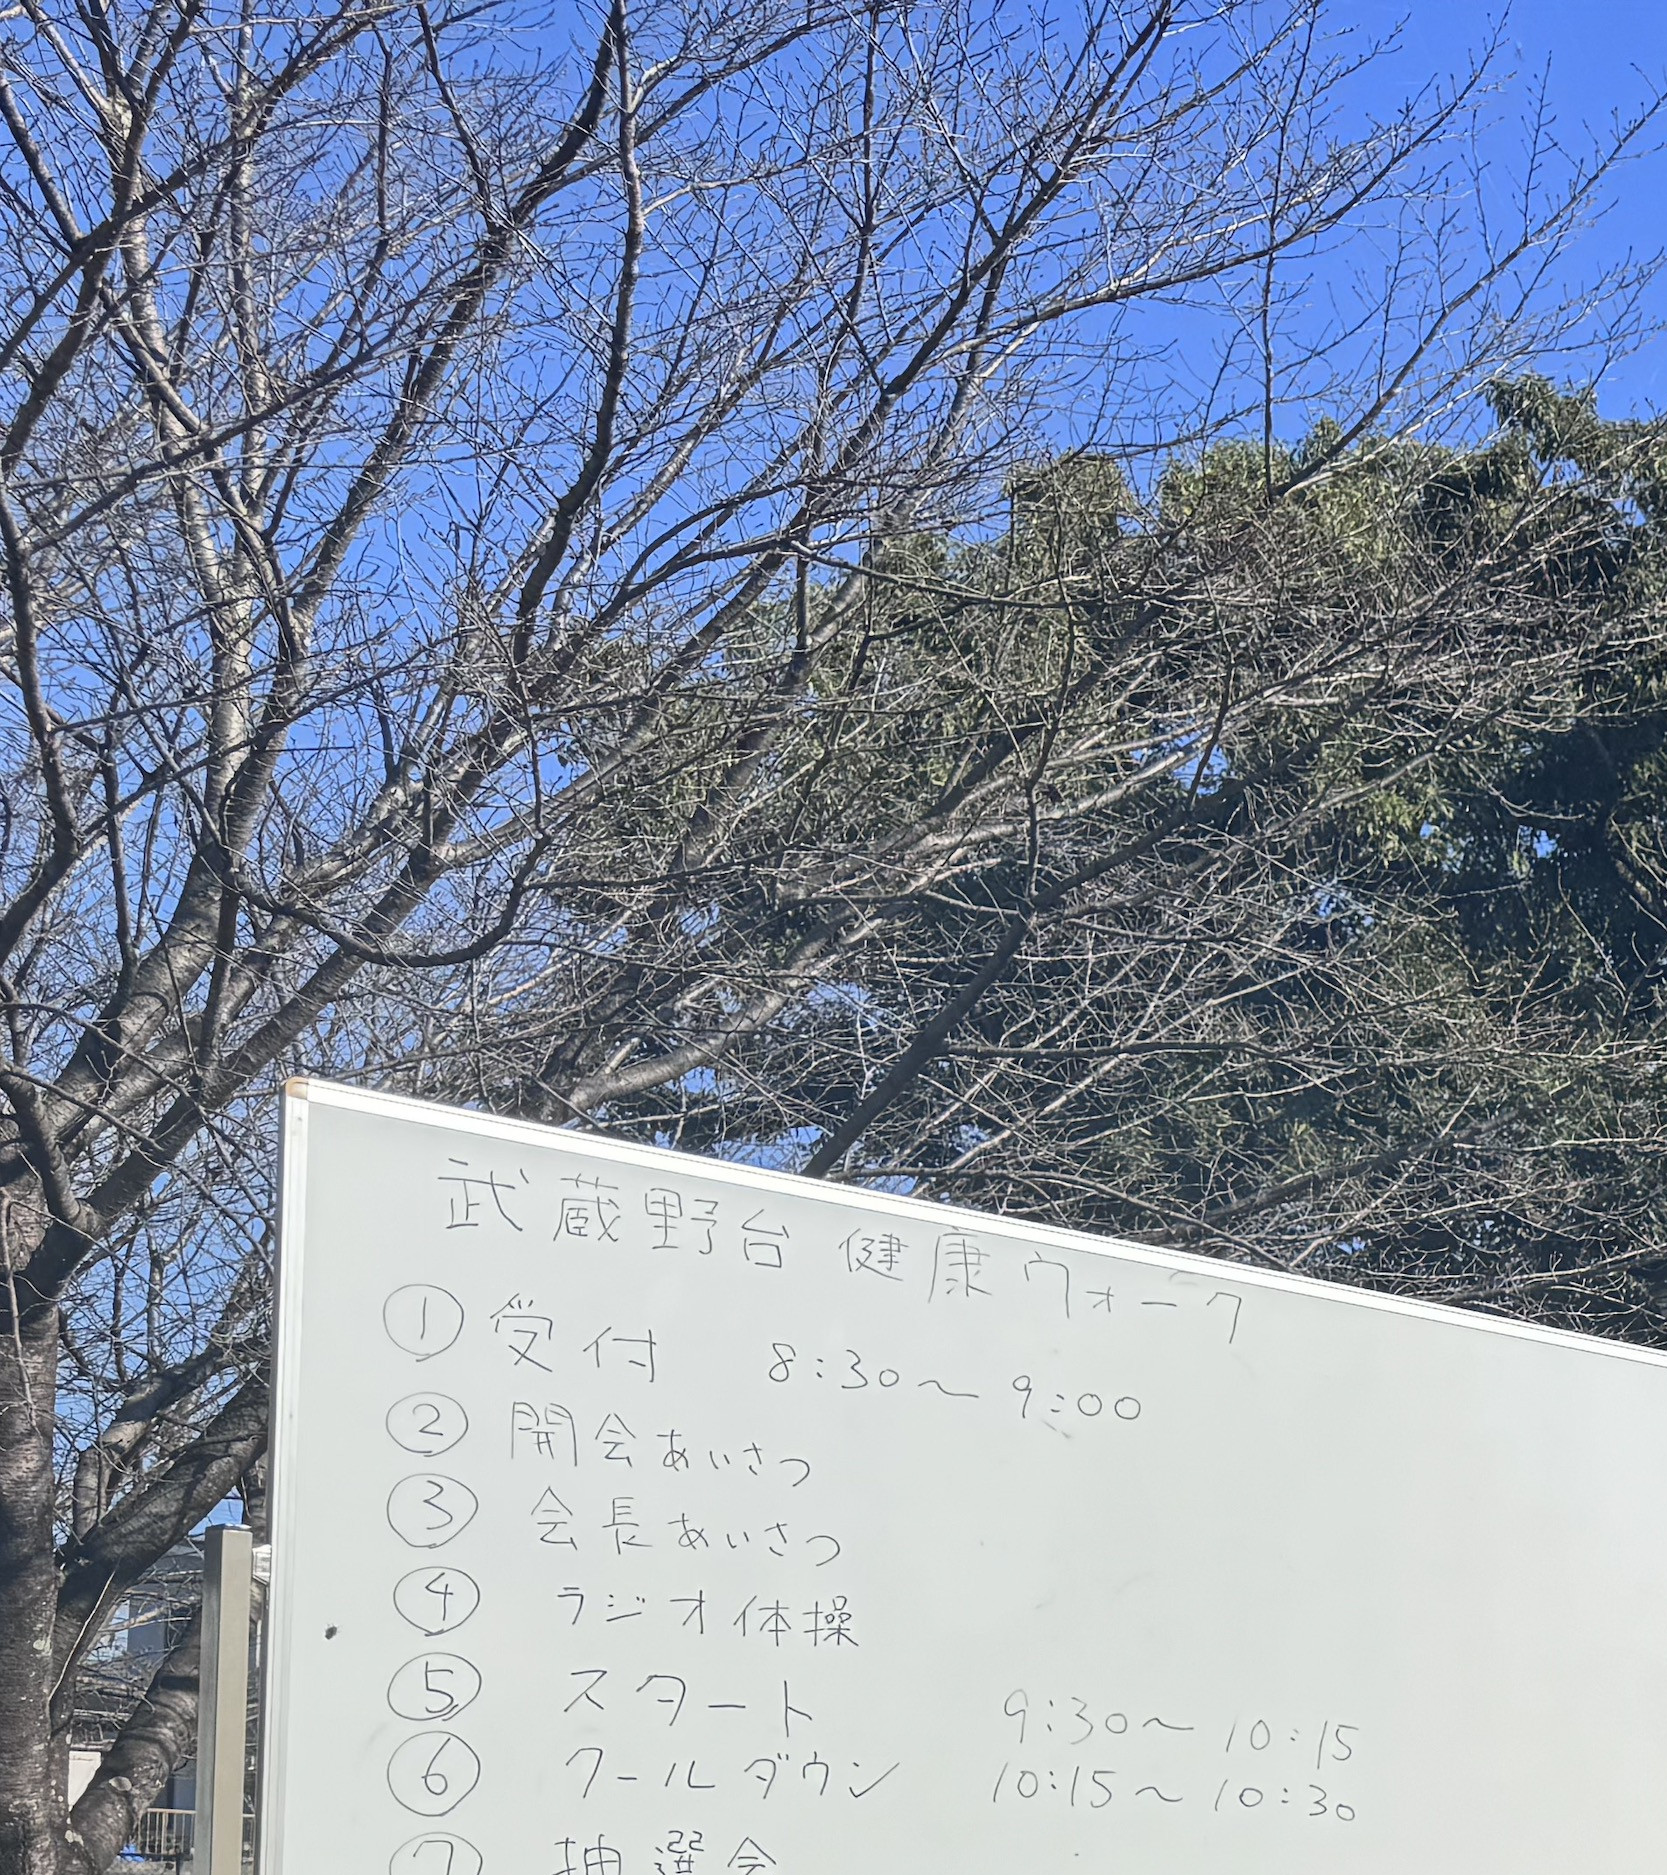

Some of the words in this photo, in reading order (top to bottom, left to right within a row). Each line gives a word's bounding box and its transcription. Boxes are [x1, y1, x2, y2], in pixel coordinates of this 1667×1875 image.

[437, 1157, 791, 1269] 武蔵野台
[838, 1226, 1244, 1345] 健康ウォーク
[490, 1293, 657, 1383] 受付
[511, 1401, 810, 1488] 開会あいさつ
[531, 1486, 840, 1567] 会長あいさつ
[557, 1587, 859, 1648] ラジオ体操
[564, 1670, 813, 1738] スタート
[565, 1747, 900, 1800] クールダウン
